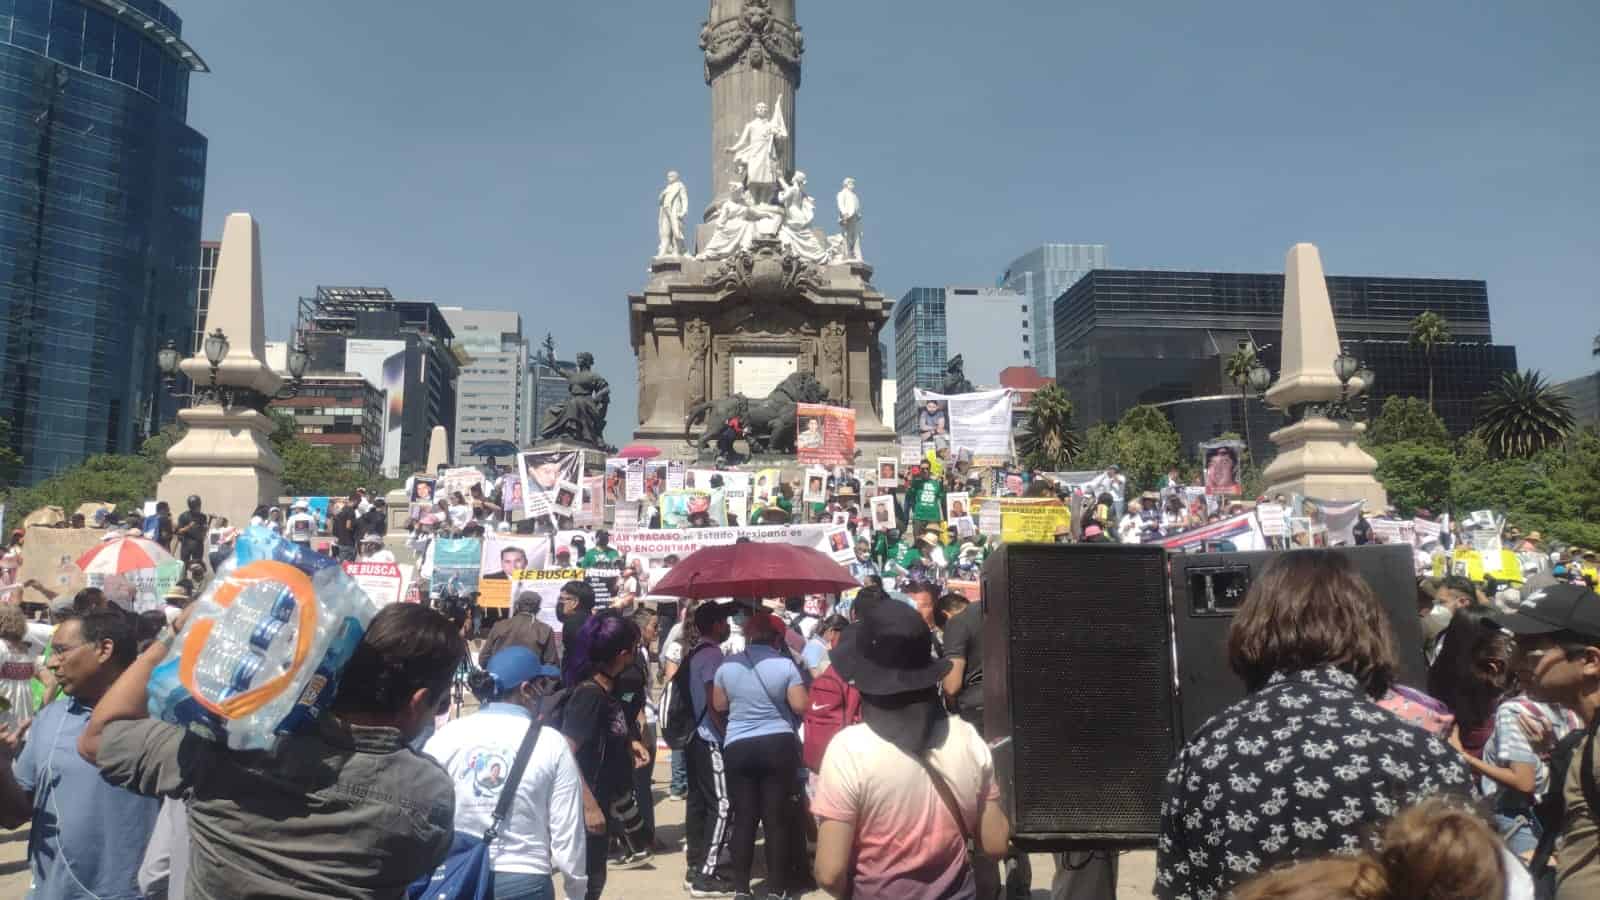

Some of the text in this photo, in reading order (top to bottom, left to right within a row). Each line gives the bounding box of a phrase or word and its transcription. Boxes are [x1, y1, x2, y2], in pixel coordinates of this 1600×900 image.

[360, 564, 397, 576] BUSCA
[519, 569, 535, 580] SE
[536, 569, 578, 580] BUSCA
